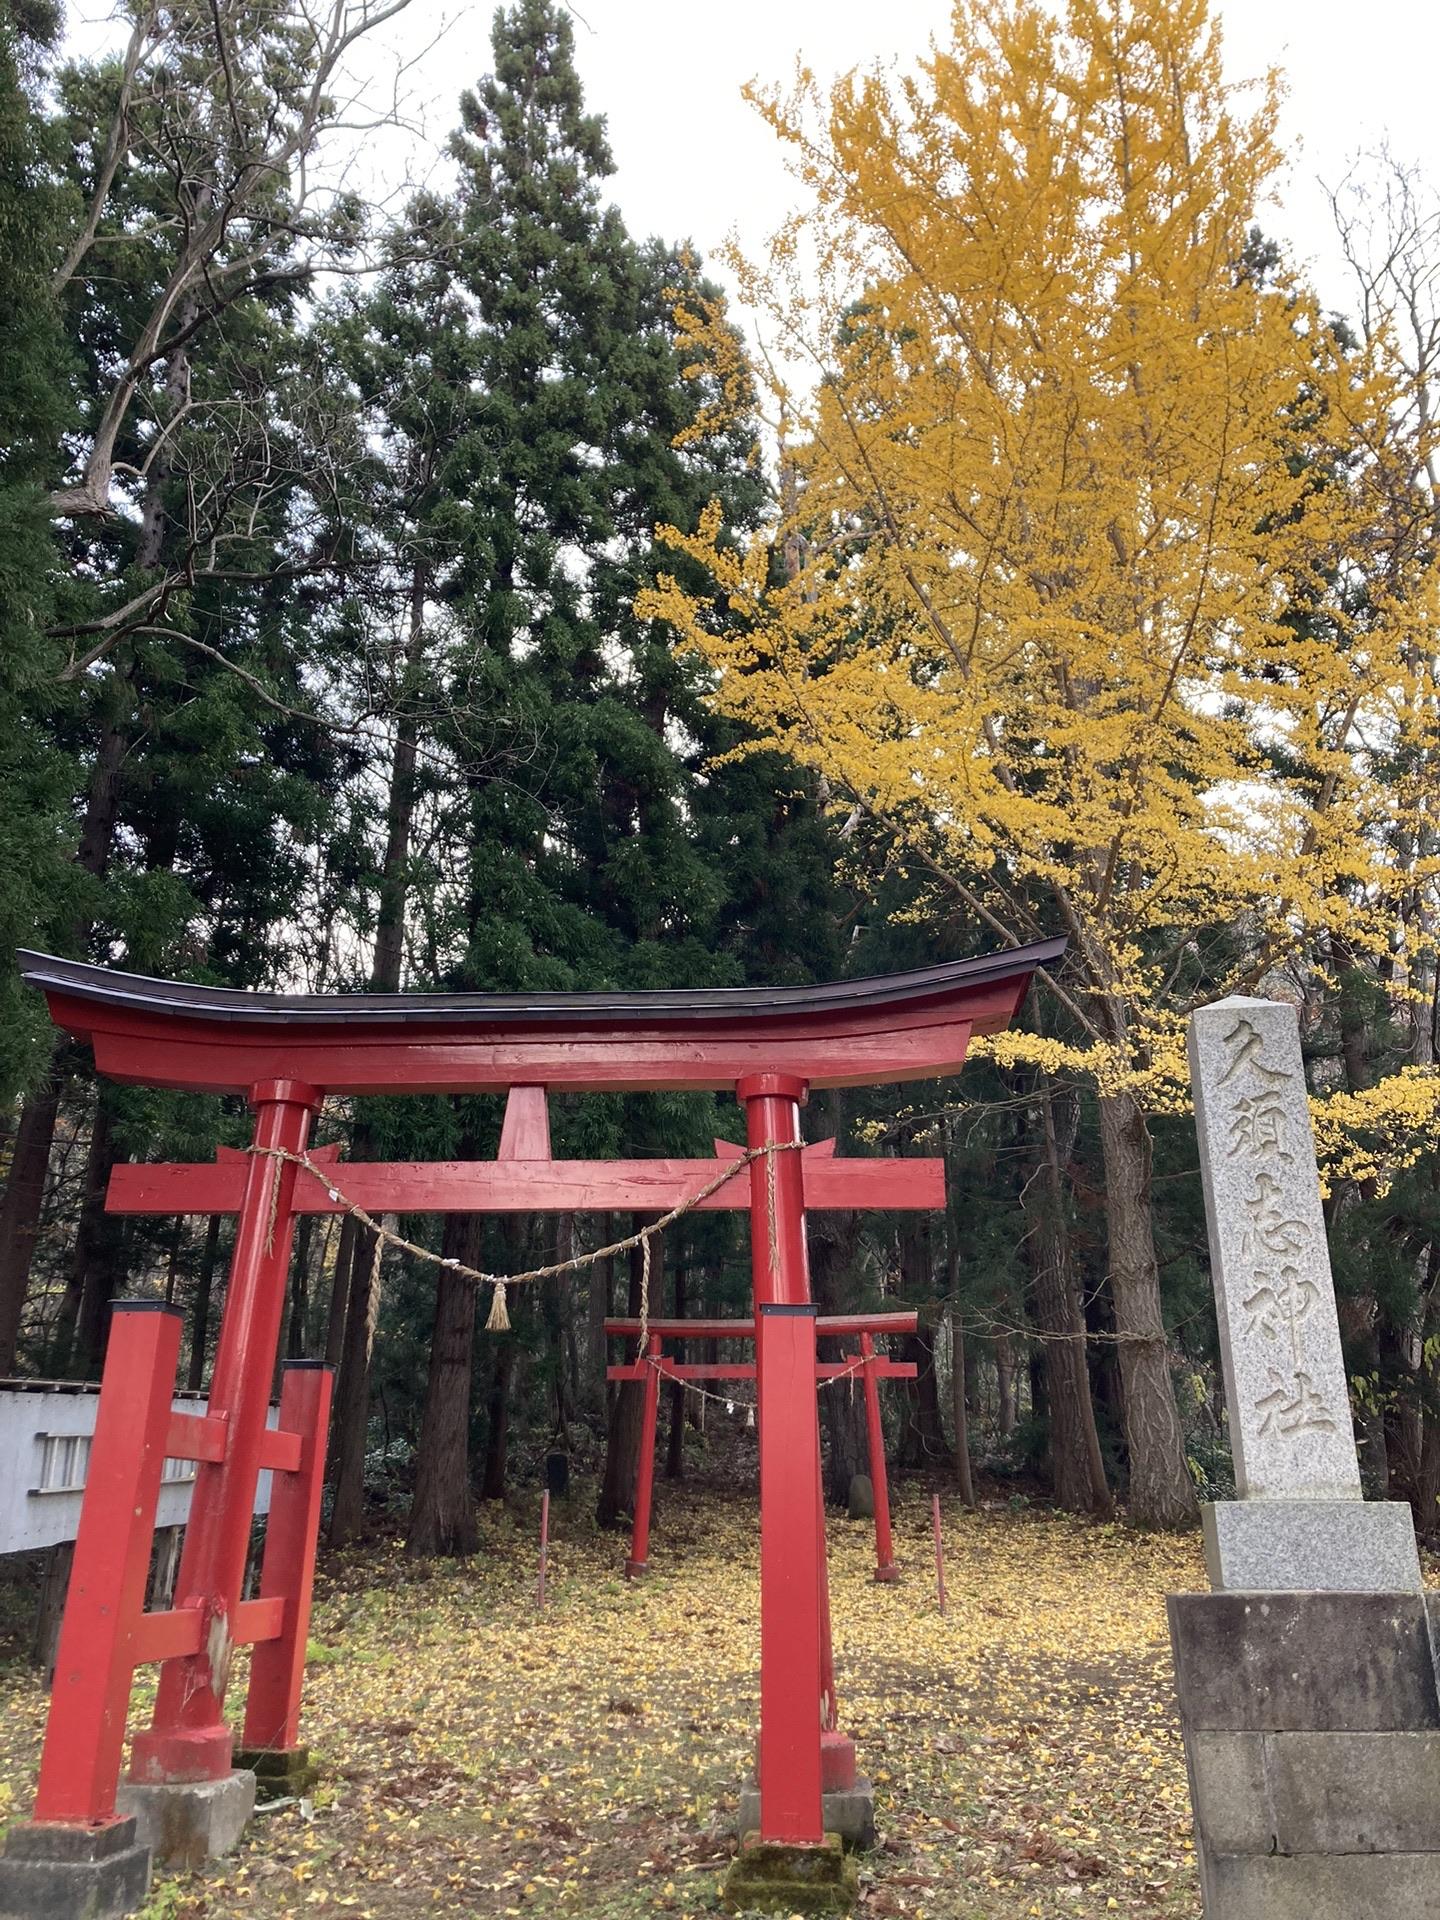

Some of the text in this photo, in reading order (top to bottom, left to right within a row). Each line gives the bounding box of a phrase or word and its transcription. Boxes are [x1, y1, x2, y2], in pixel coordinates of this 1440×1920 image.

[1213, 1019, 1337, 1439] 久須志神社
